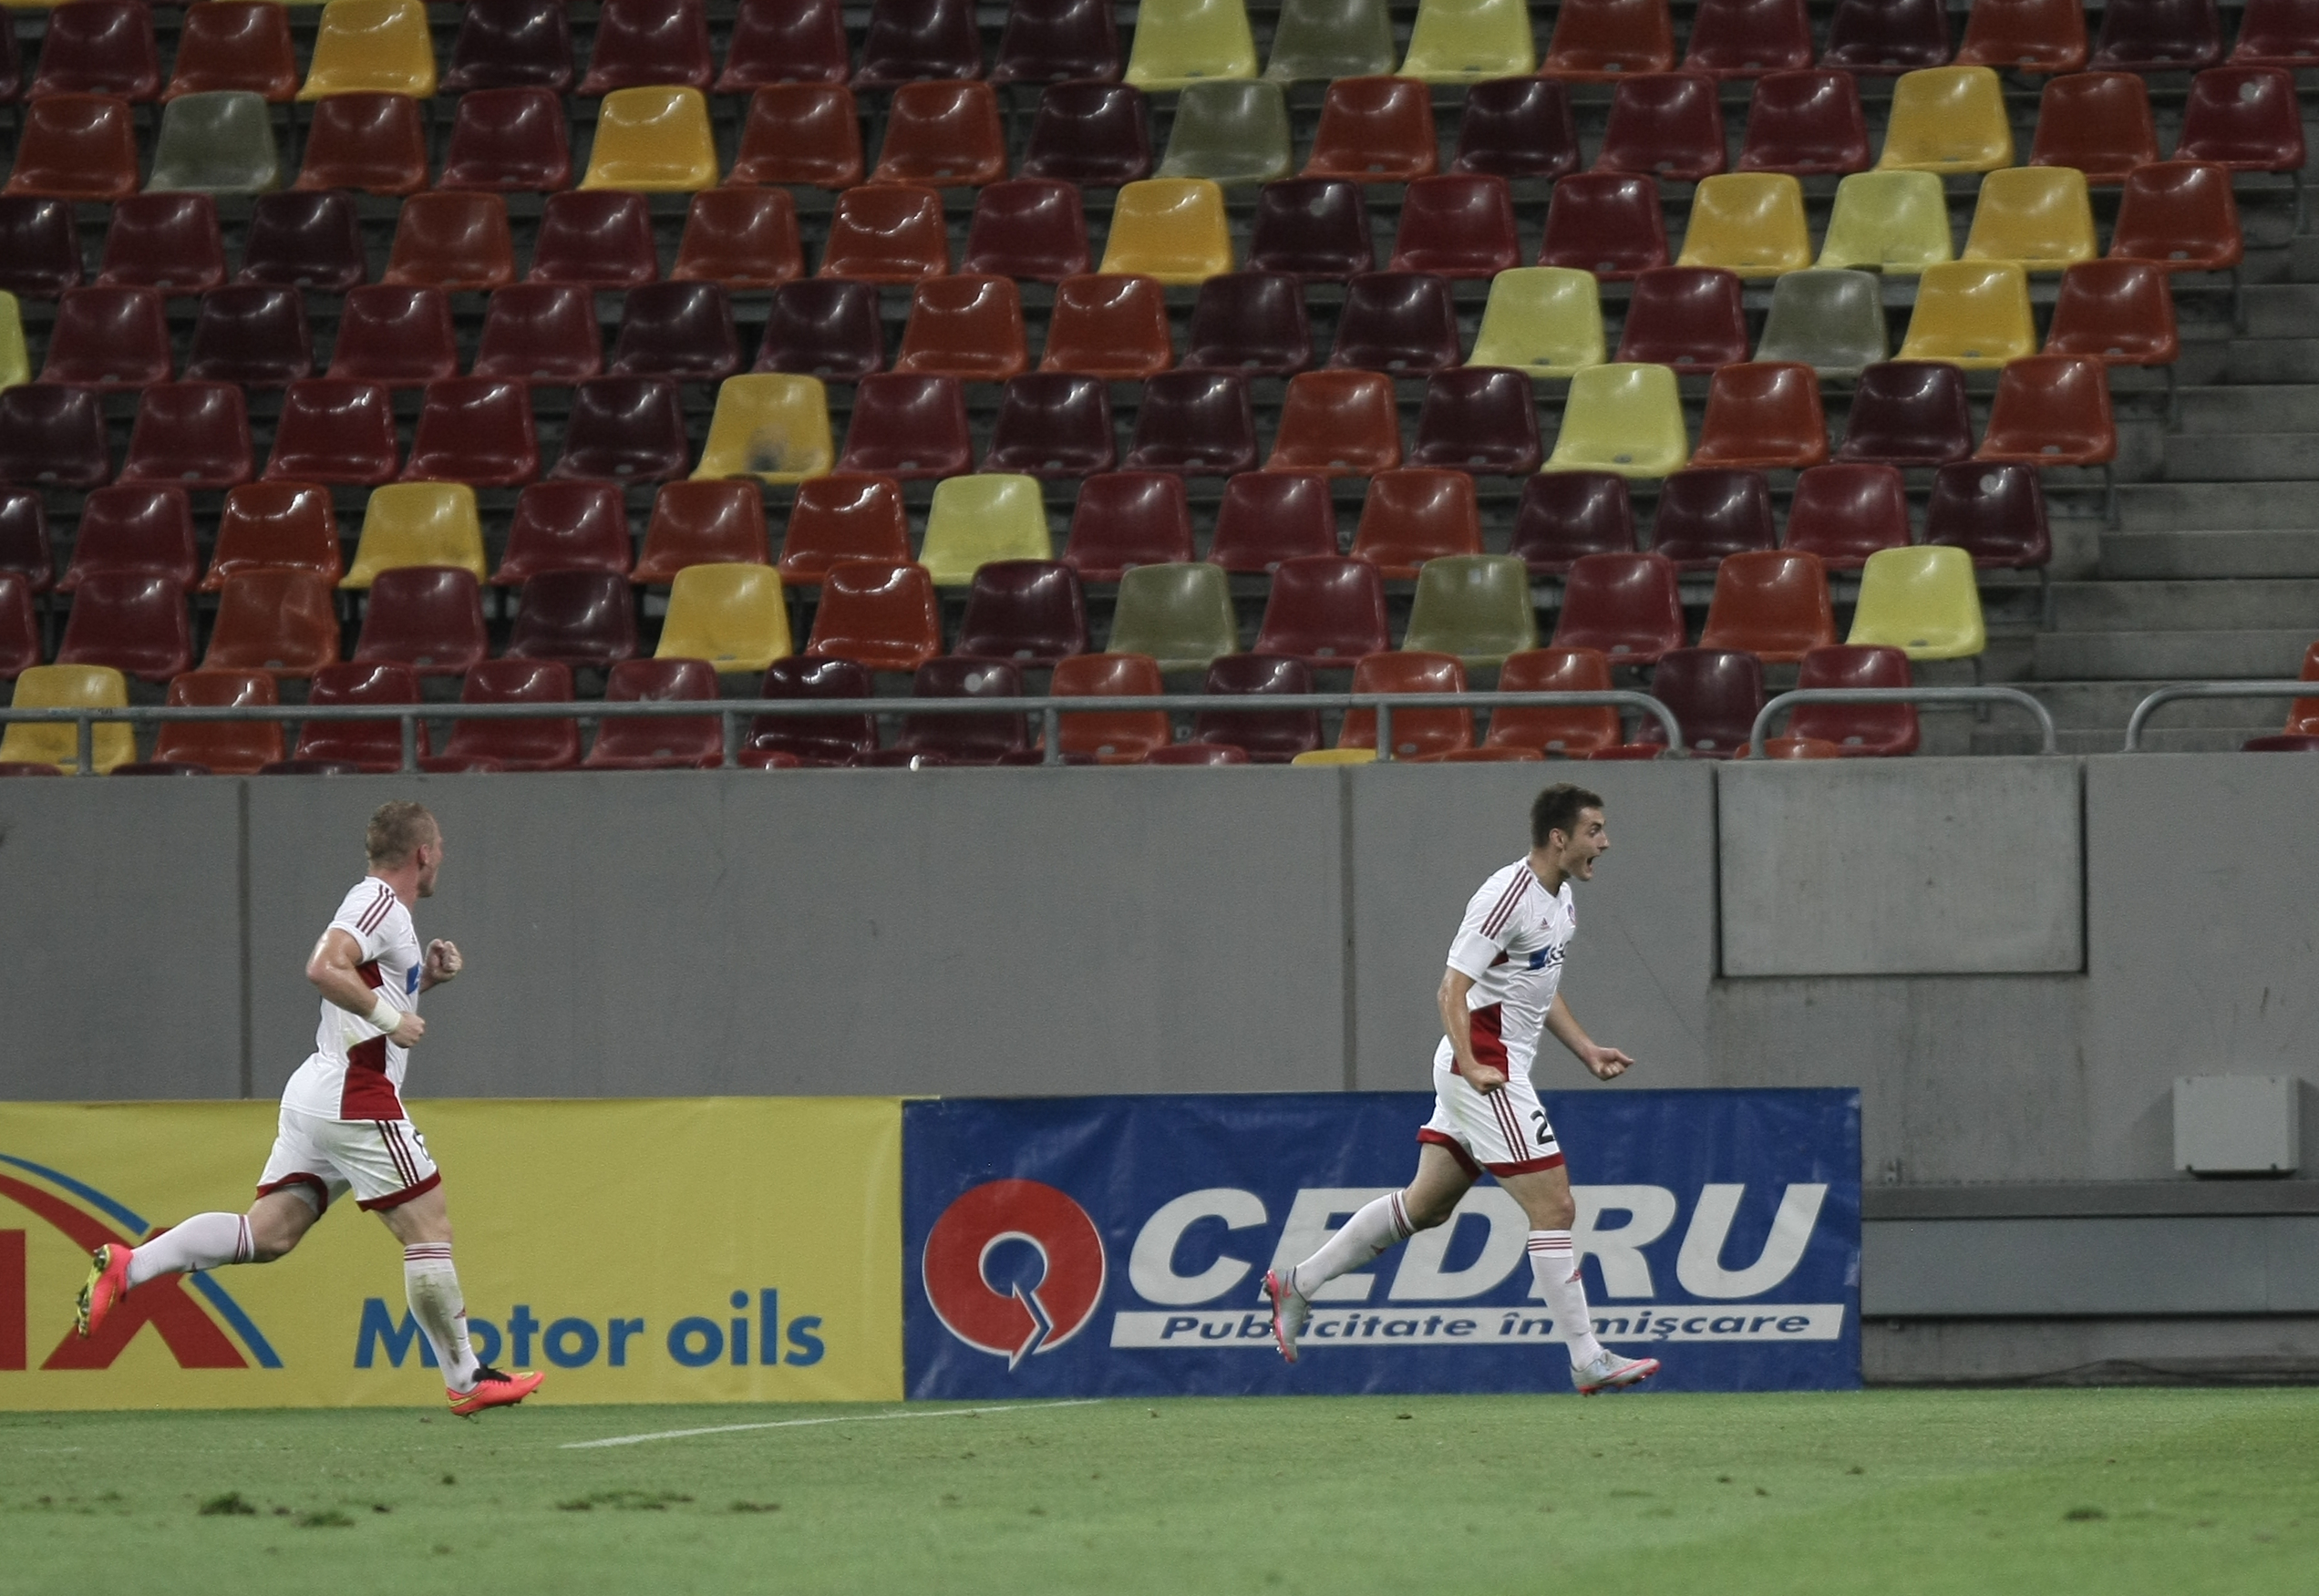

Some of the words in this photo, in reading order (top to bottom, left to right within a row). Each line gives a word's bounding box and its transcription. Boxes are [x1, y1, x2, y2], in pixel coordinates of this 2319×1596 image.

[1530, 1109, 1555, 1146] 2
[1129, 1183, 1829, 1305] CEDRU
[0, 1227, 250, 1371] X
[354, 1297, 644, 1369] Motor
[666, 1287, 825, 1367] oils
[1160, 1313, 1478, 1341] Pubicitate
[1499, 1311, 1554, 1335] în
